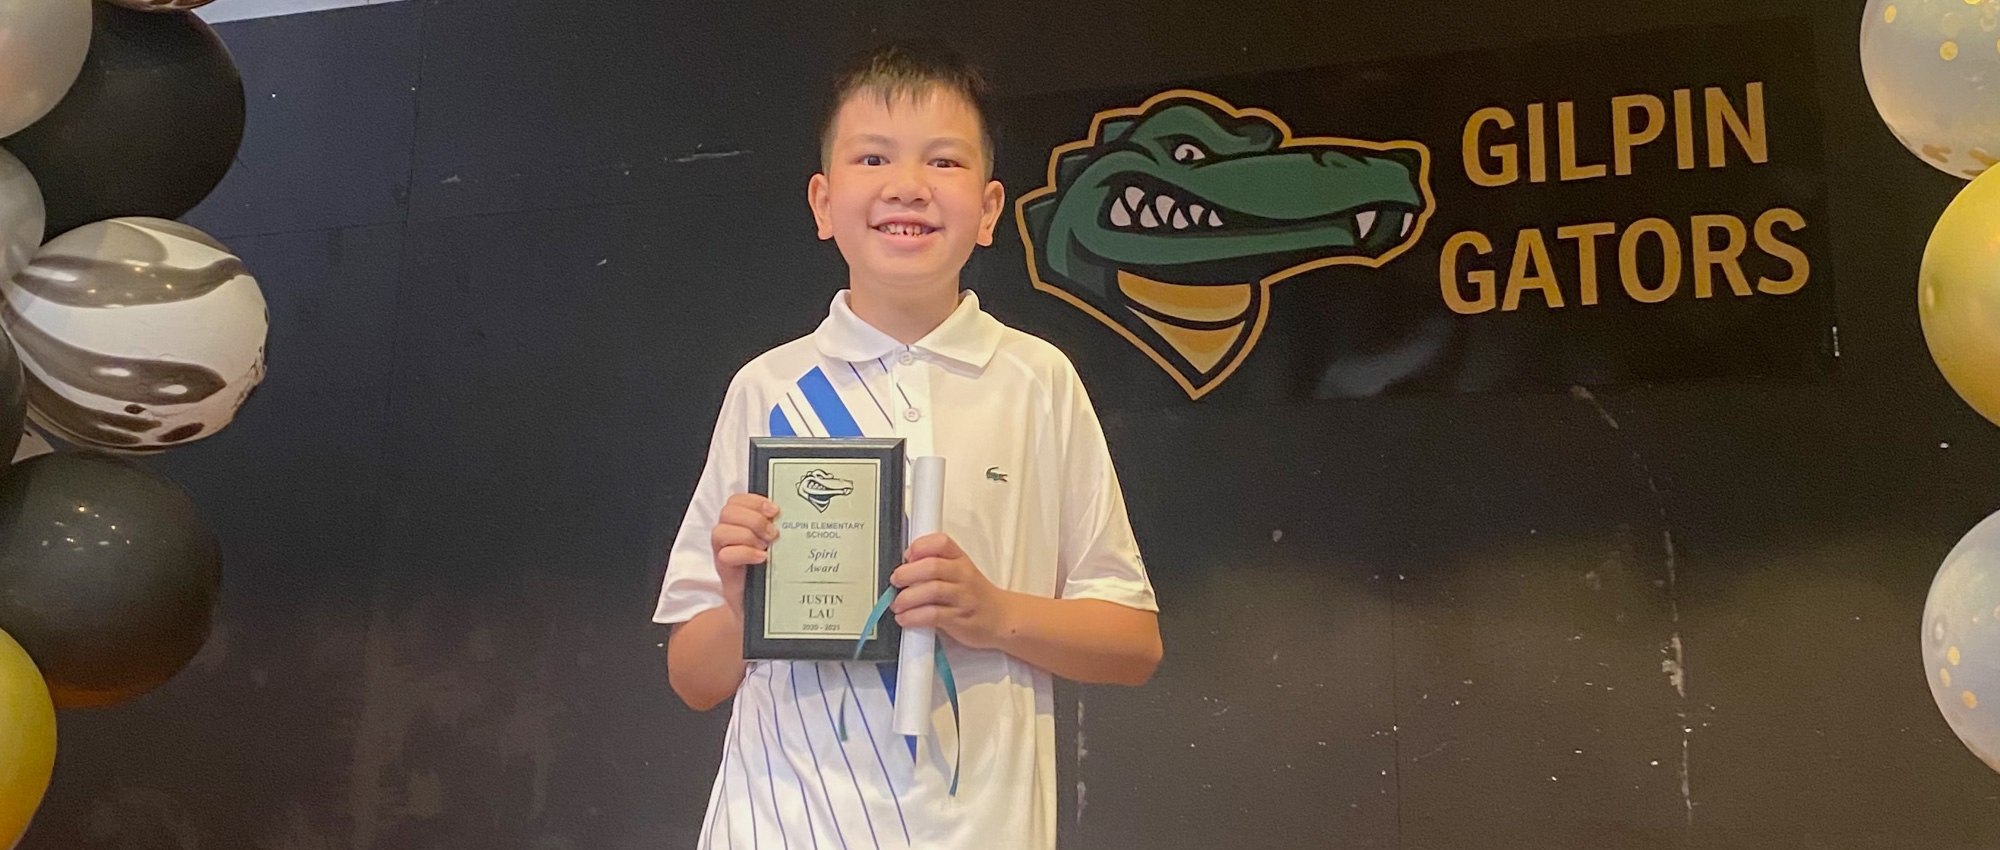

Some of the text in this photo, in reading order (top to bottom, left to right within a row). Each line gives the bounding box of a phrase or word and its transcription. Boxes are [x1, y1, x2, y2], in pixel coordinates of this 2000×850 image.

[1462, 82, 1768, 187] GILPIN
[1439, 207, 1810, 315] GATORS
[782, 522, 865, 530] GILPIN ELEMENTARY
[806, 531, 841, 539] SCHOOL
[808, 548, 838, 561] Spirit
[805, 562, 840, 573] Award
[799, 594, 844, 605] JUSTIN
[808, 608, 835, 619] LAU
